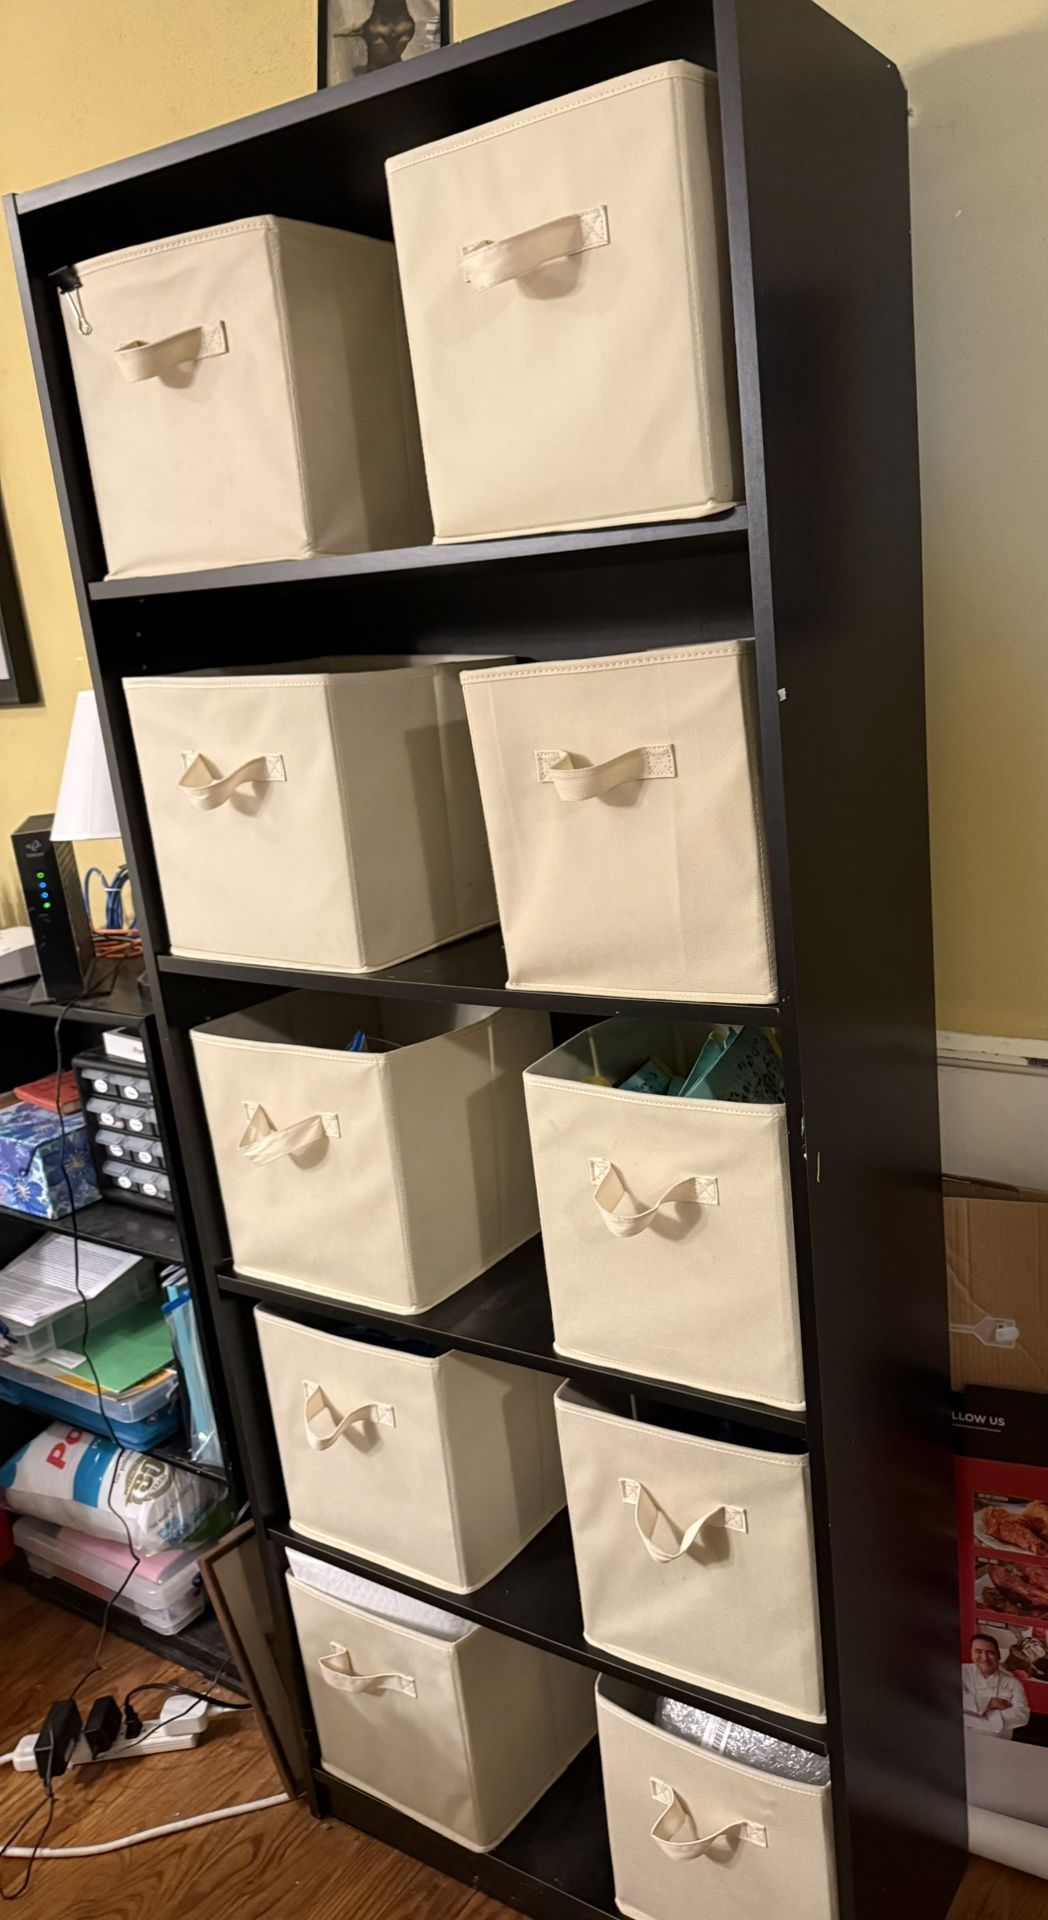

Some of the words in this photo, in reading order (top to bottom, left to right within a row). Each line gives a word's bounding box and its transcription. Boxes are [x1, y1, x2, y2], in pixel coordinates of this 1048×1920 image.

[952, 1411, 986, 1424] LLOW
[989, 1416, 1005, 1426] US
[46, 1428, 83, 1470] Po
